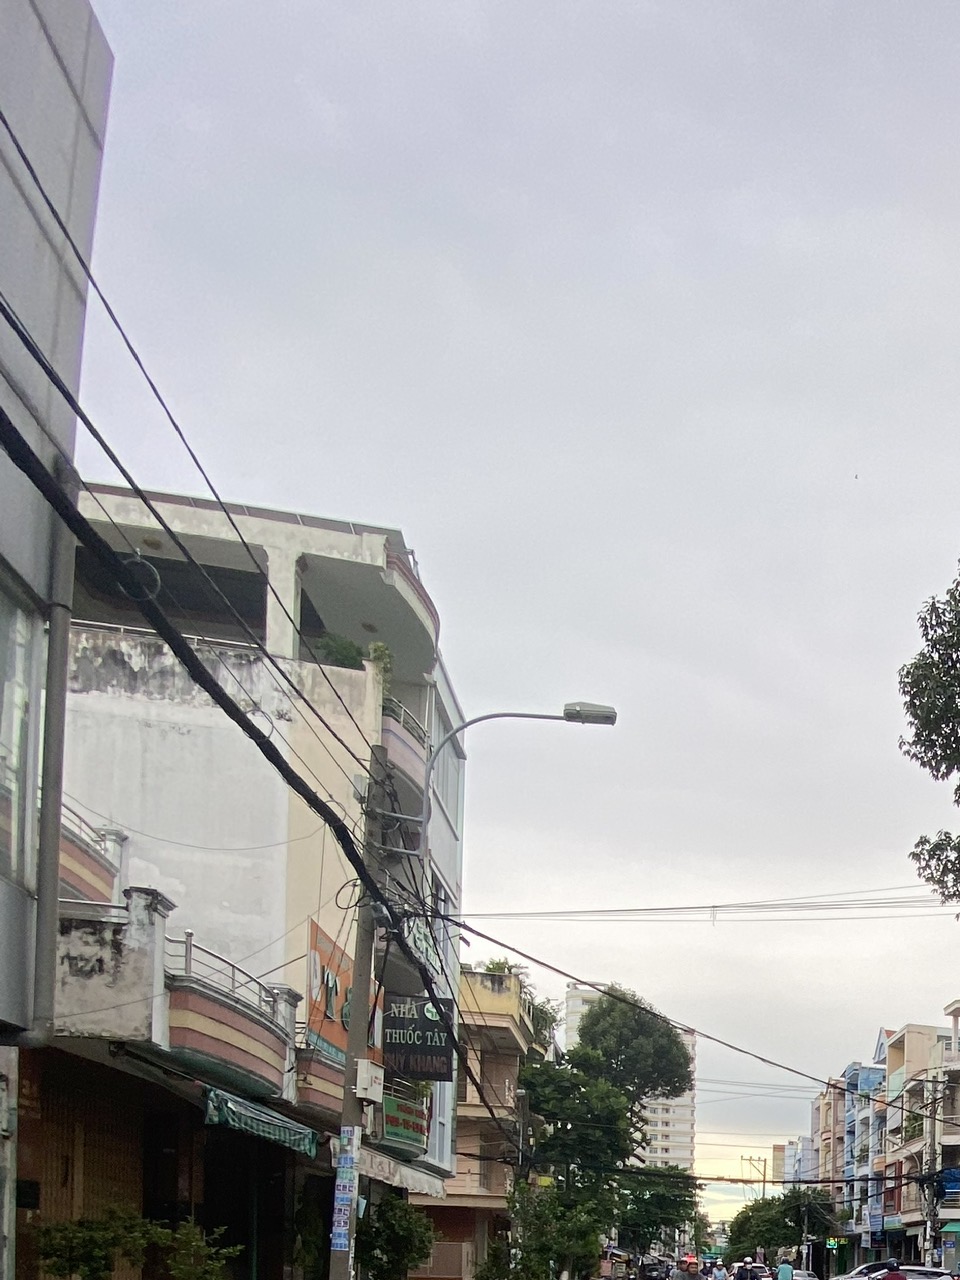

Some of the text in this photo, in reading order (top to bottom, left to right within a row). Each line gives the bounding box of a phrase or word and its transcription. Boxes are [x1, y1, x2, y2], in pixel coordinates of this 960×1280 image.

[390, 998, 418, 1019] NHÀ
[385, 1024, 448, 1047] THUỐC TÂY
[409, 1055, 448, 1073] KHANG
